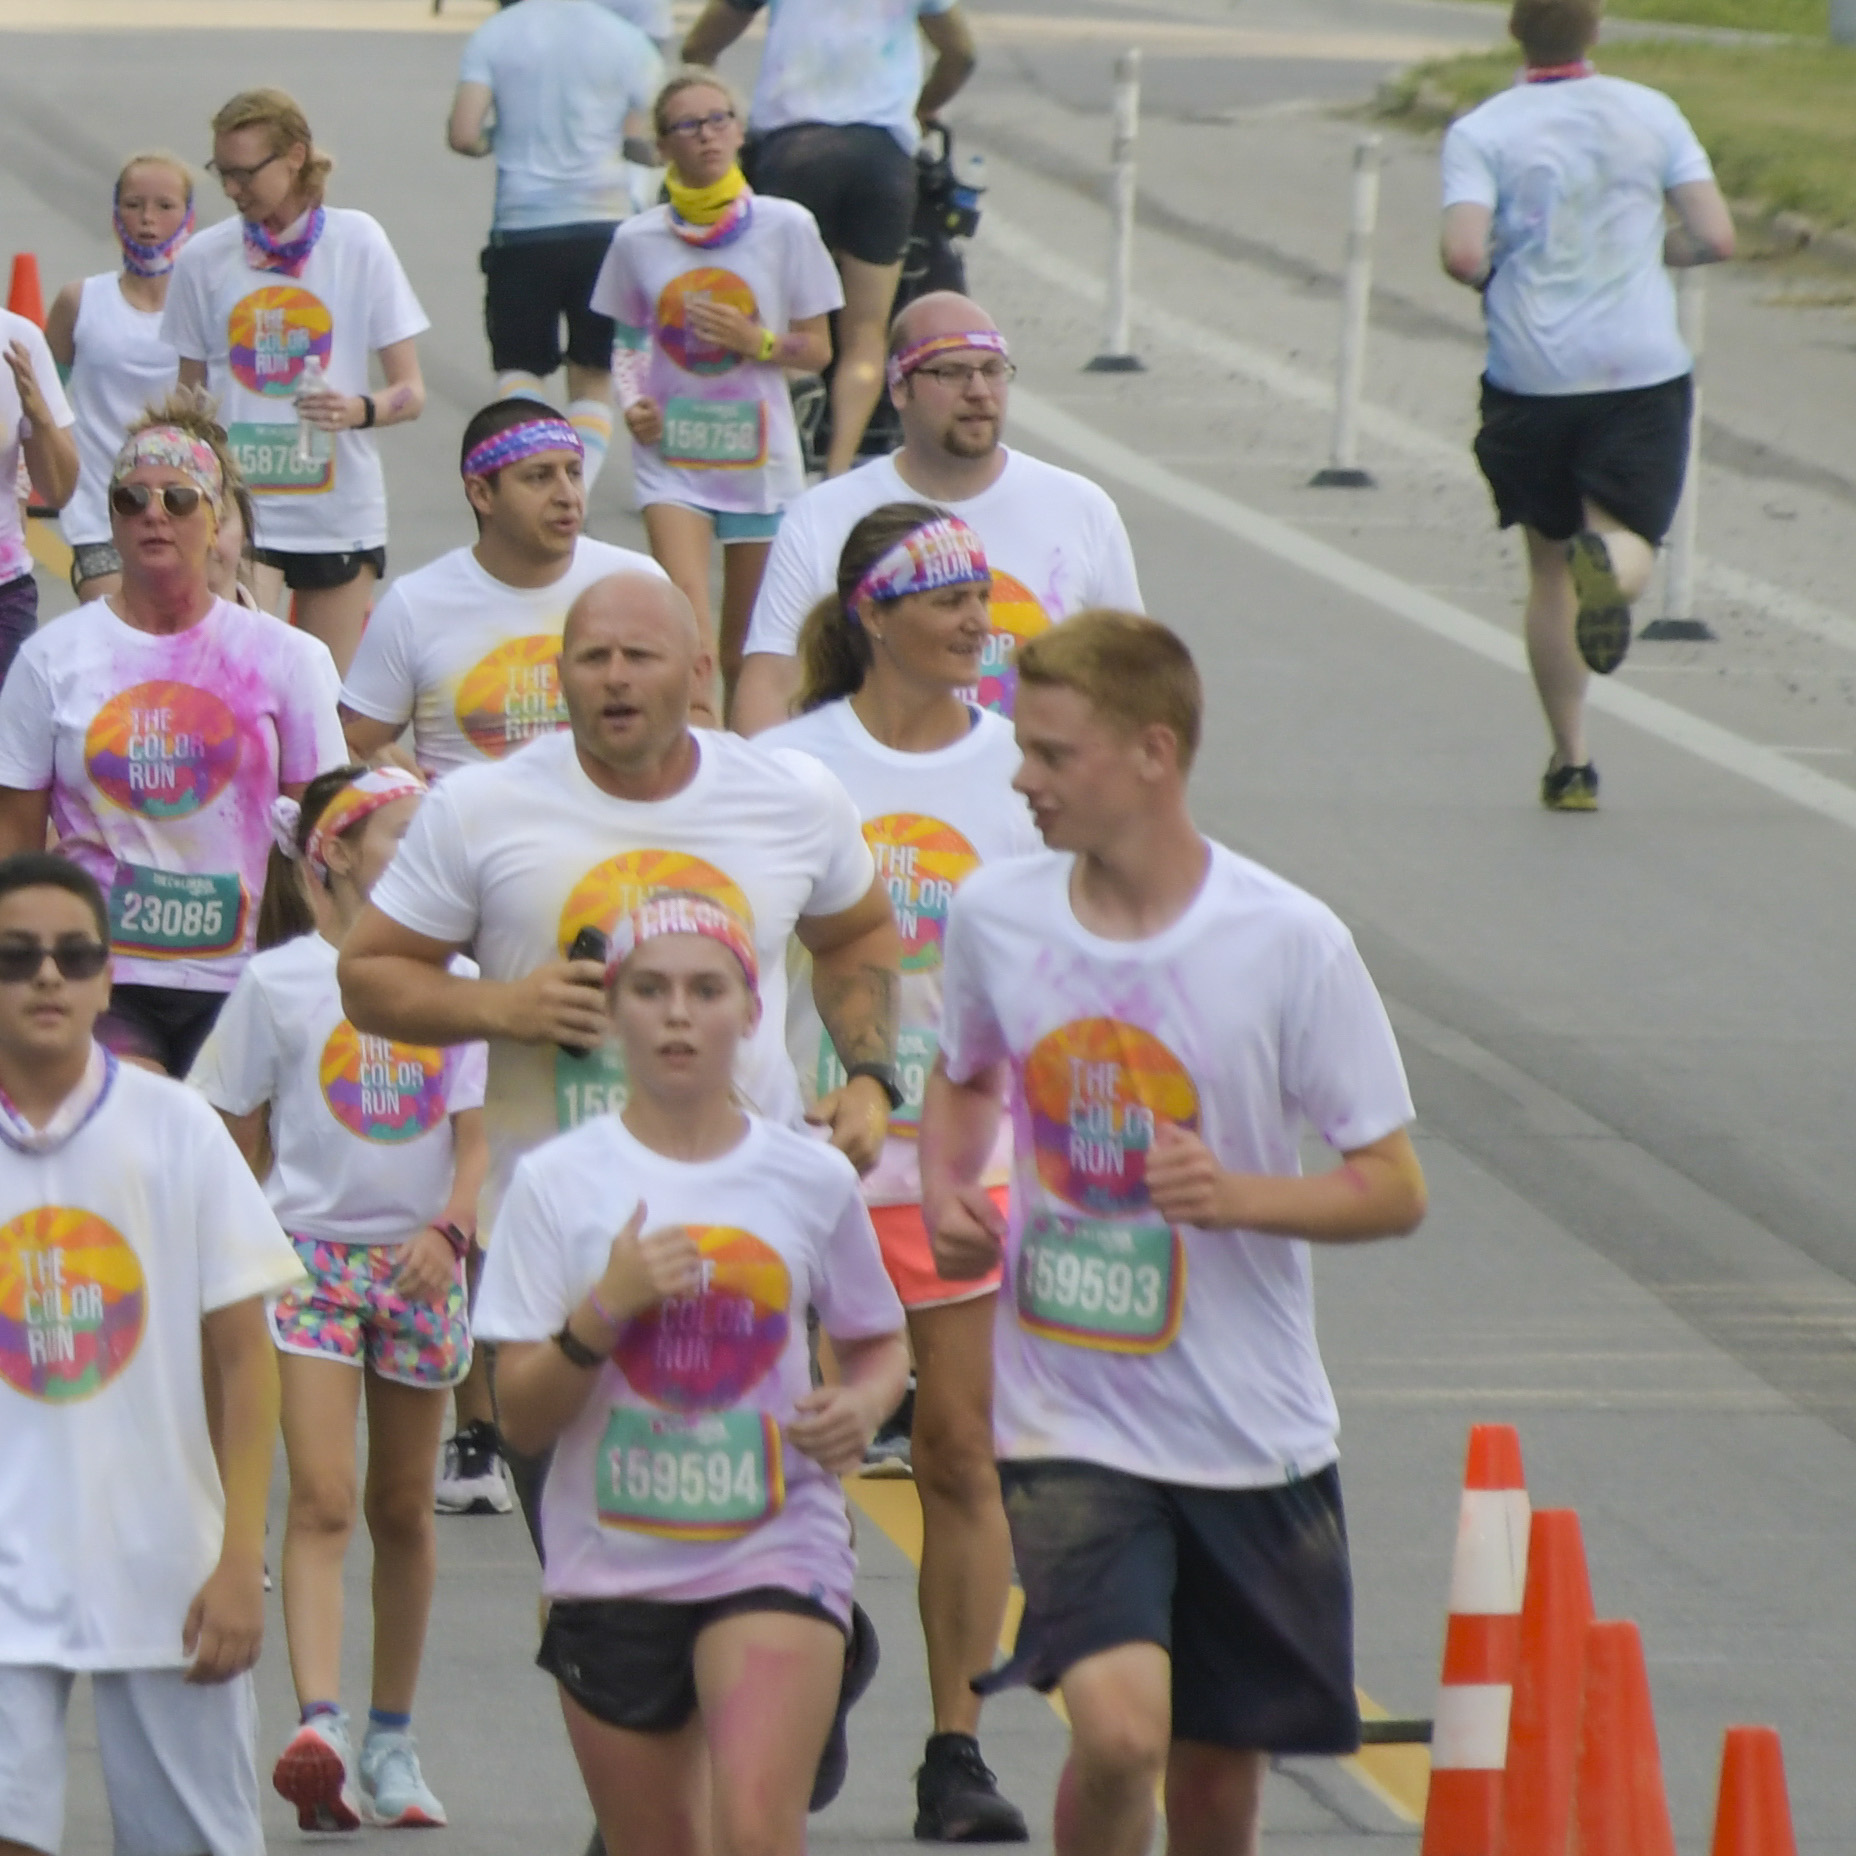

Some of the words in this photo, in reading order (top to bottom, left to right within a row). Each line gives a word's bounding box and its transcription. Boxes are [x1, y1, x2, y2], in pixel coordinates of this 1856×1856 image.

[256, 352, 290, 375] RUN
[130, 707, 174, 736] THE
[129, 731, 206, 762] COLOR
[129, 762, 176, 790] RUN
[874, 842, 919, 879] THE
[120, 890, 224, 936] 23085
[358, 1033, 394, 1065] THE
[360, 1061, 425, 1089] COLOR
[1069, 1056, 1122, 1106] THE
[361, 1087, 401, 1116] RUN
[1071, 1134, 1126, 1177] RUN
[21, 1246, 68, 1290] THE
[24, 1284, 105, 1325] COLOR
[28, 1323, 76, 1366] RUN
[608, 1446, 759, 1507] 159594
